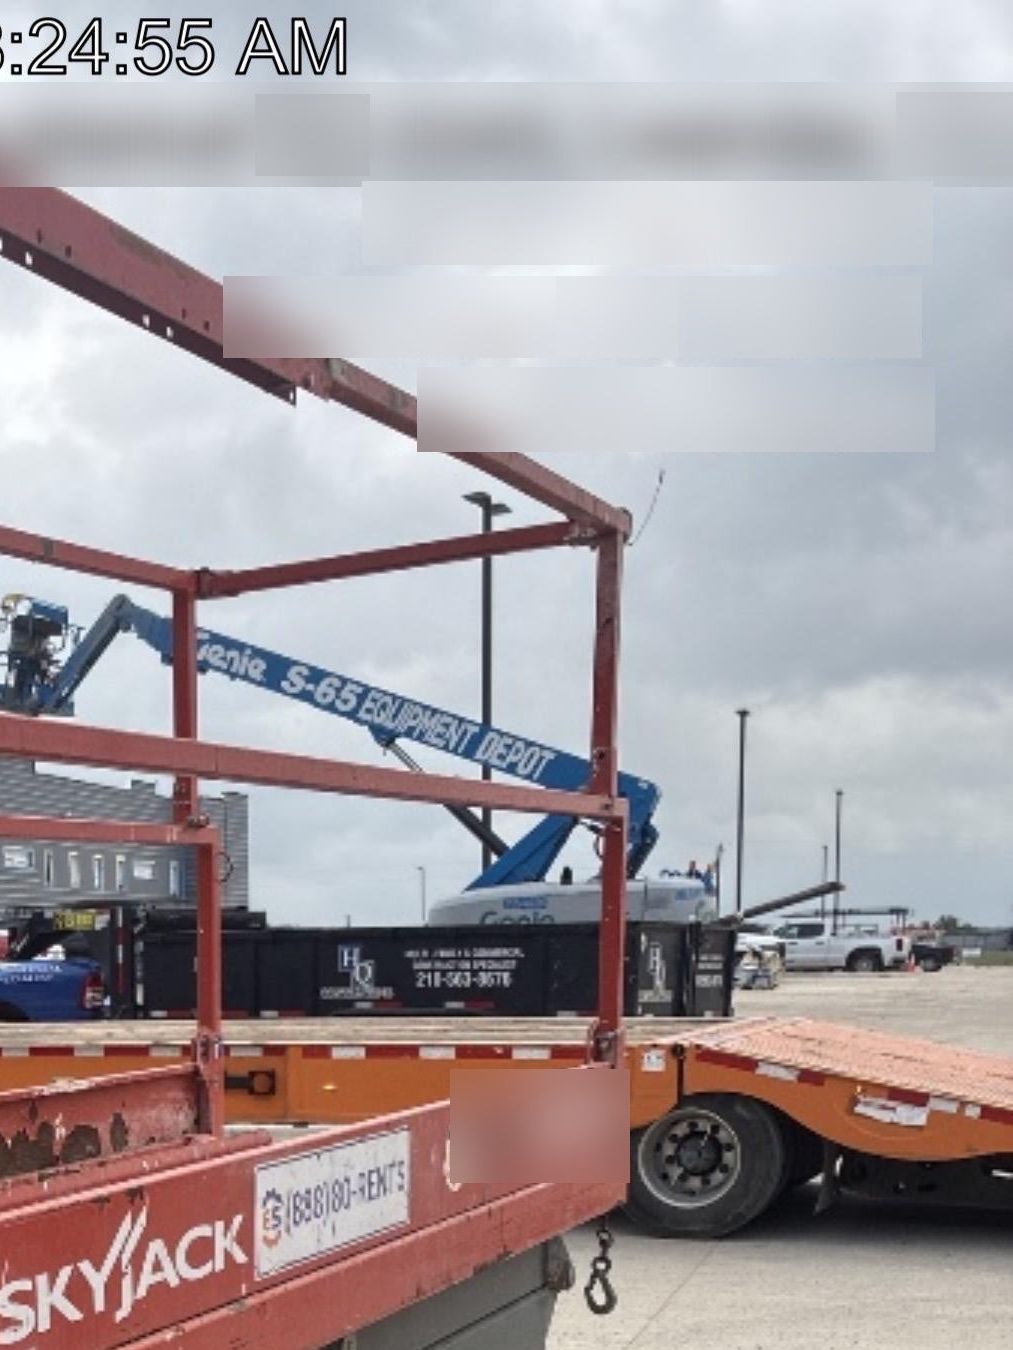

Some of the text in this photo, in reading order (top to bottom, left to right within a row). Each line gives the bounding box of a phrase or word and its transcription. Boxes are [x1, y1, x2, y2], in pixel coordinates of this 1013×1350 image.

[281, 665, 363, 712] S-65
[358, 691, 557, 781] EQUIPMENT DEPOT
